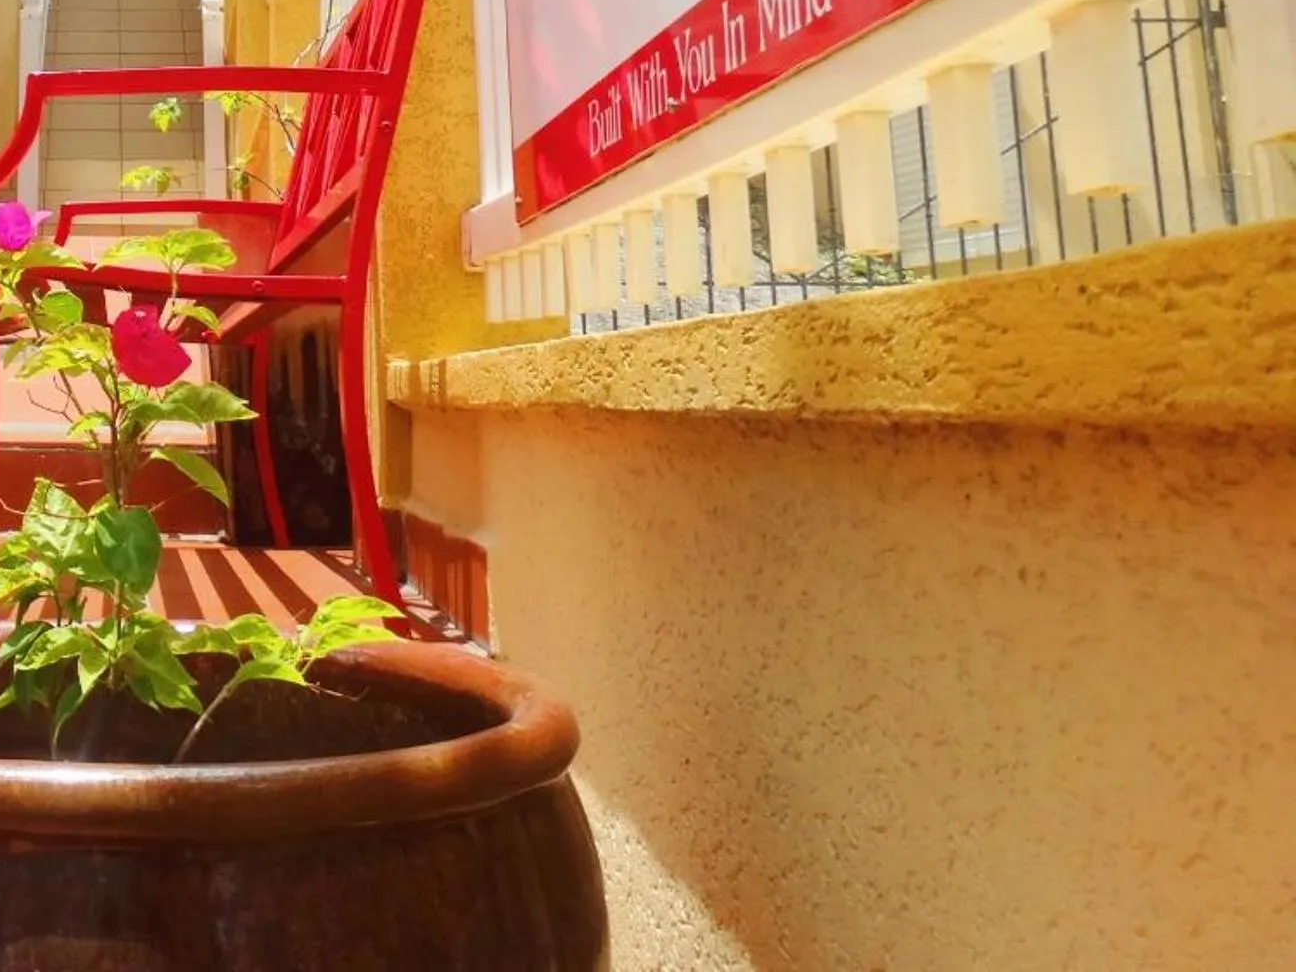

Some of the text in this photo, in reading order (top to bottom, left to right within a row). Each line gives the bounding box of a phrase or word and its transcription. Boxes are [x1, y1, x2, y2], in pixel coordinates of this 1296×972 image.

[588, 79, 623, 158] Built
[626, 50, 669, 132] With
[673, 27, 717, 104] You
[722, 0, 748, 75] In
